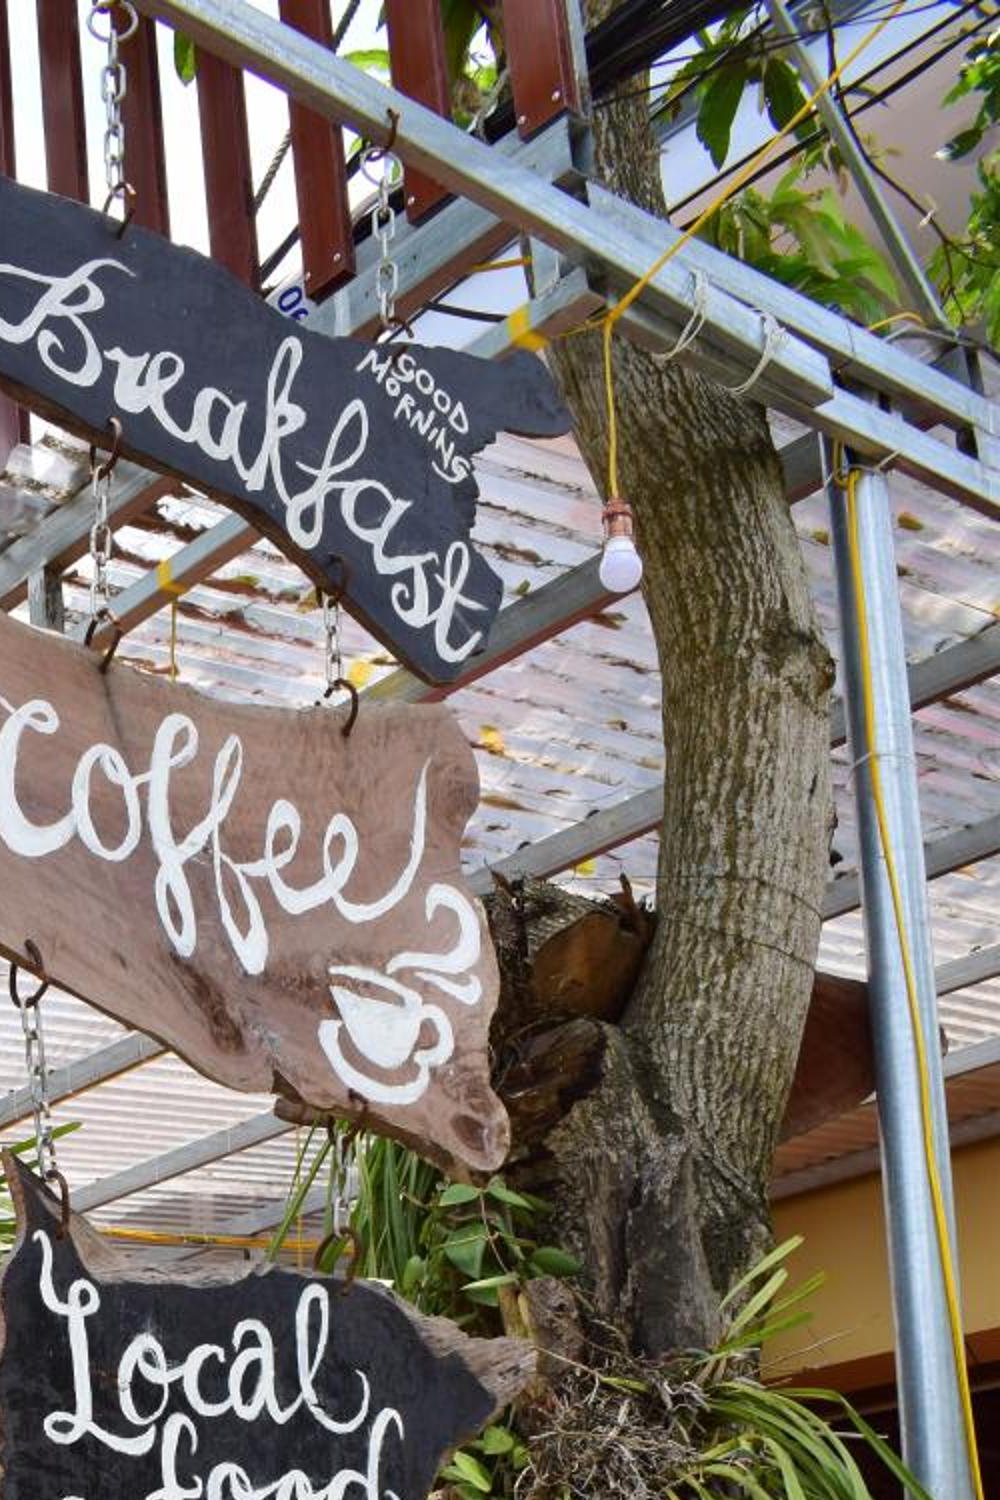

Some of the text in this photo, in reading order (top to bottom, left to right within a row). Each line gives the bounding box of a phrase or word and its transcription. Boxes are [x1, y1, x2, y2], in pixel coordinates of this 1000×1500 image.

[355, 349, 472, 483] MORNING
[391, 353, 469, 434] GOOD
[33, 1229, 371, 1456] Local
